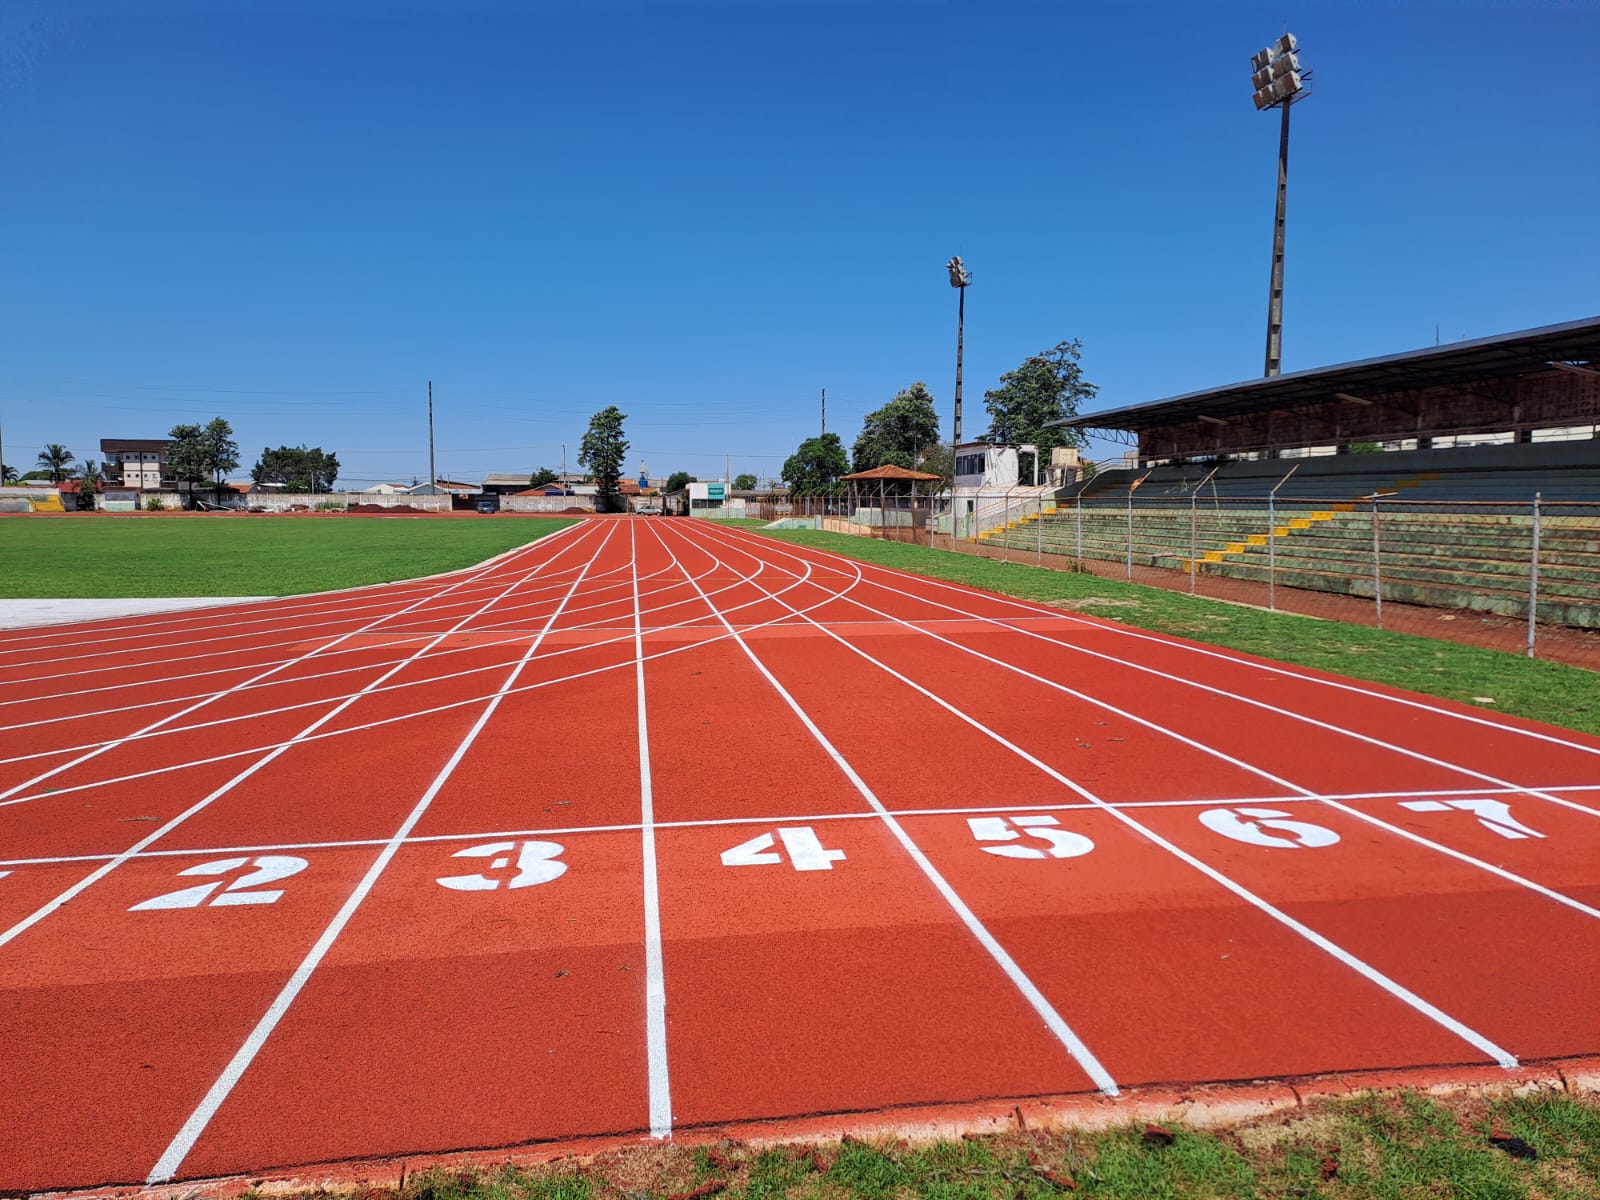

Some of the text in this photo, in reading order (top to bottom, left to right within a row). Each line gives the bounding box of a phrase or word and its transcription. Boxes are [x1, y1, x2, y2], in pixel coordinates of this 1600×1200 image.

[967, 815, 1094, 859] 5
[1199, 808, 1341, 849] 6
[1398, 799, 1546, 840] 7
[436, 841, 568, 890] 3
[720, 827, 846, 871] 4
[128, 856, 308, 911] 2
